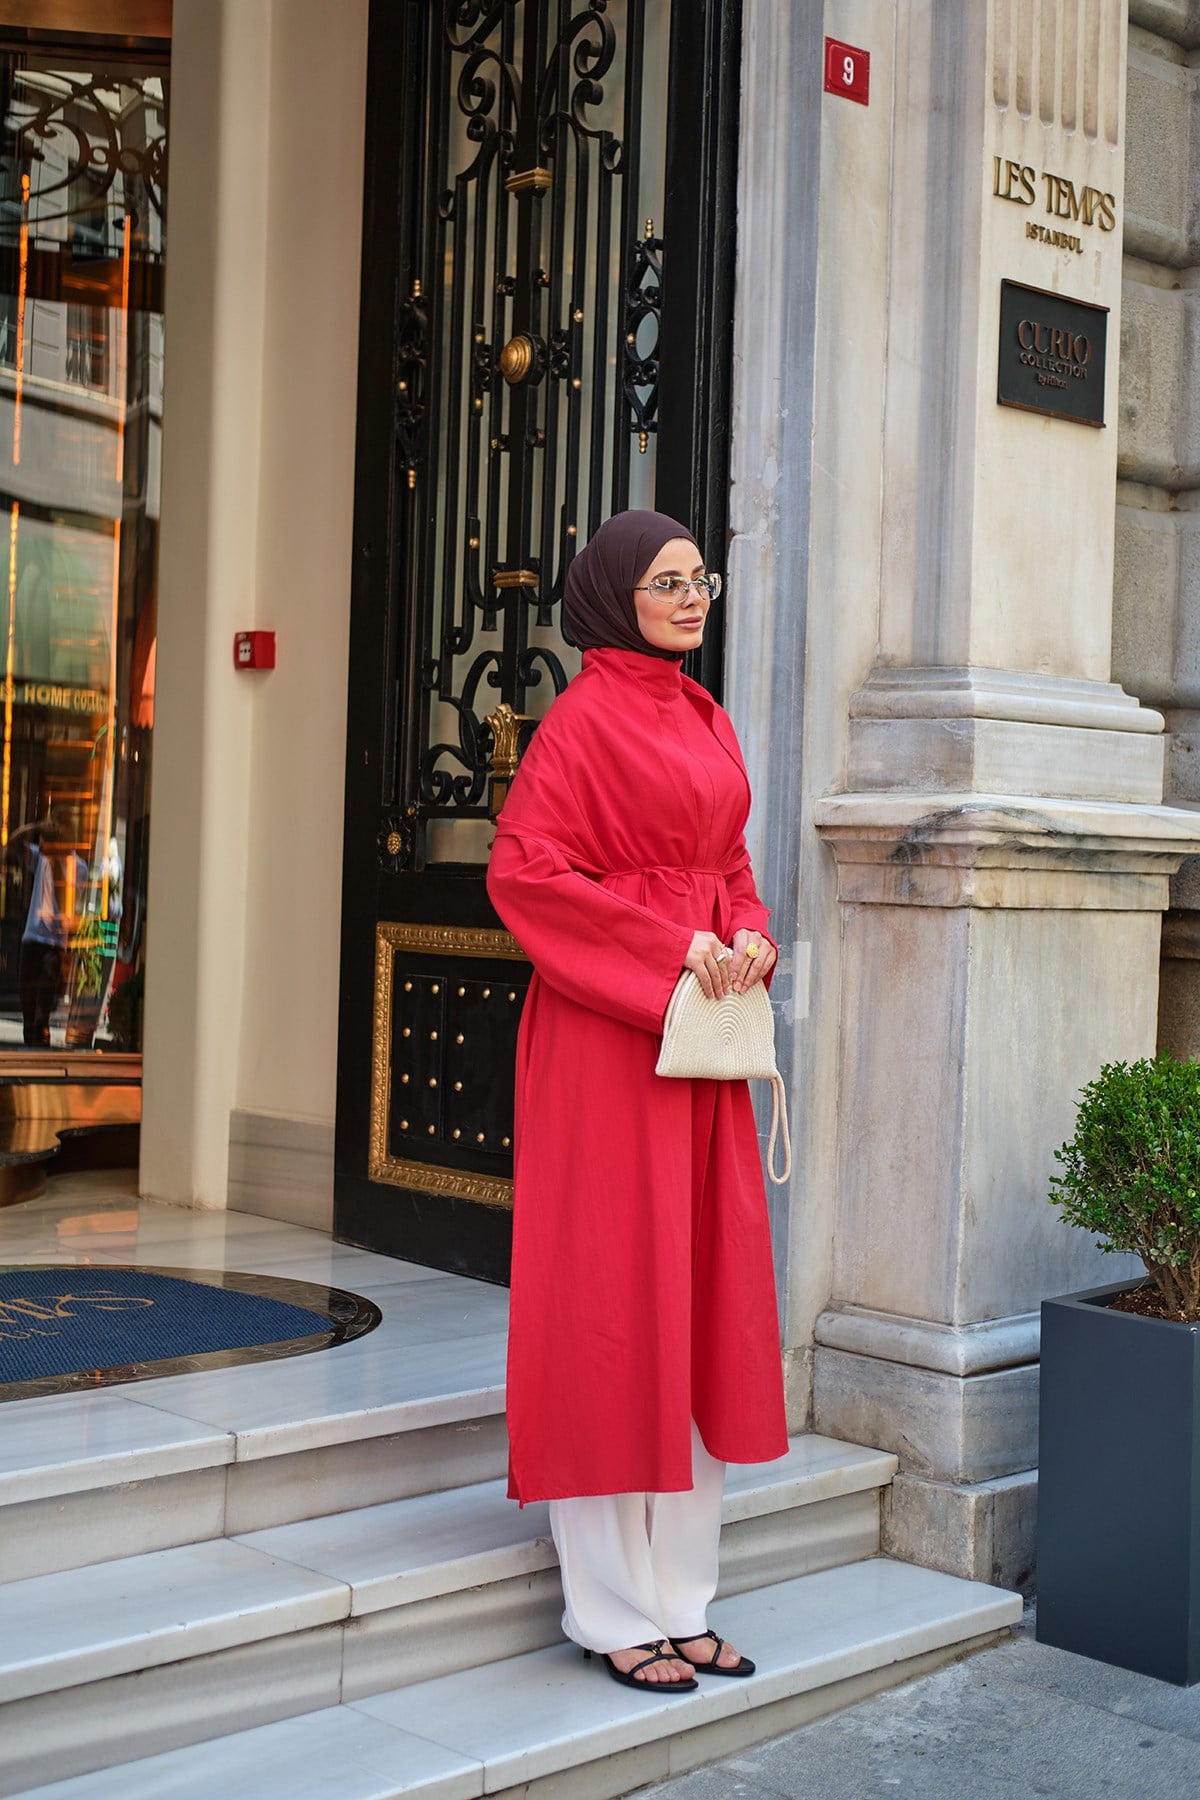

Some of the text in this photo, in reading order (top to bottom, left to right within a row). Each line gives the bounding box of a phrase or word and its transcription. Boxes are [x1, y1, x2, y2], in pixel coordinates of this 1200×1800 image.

[843, 56, 854, 86] 9
[993, 156, 1116, 232] LES TEMPS
[1018, 320, 1092, 365] CURIO
[1020, 352, 1088, 379] COLLECTION
[24, 683, 72, 709] HOME
